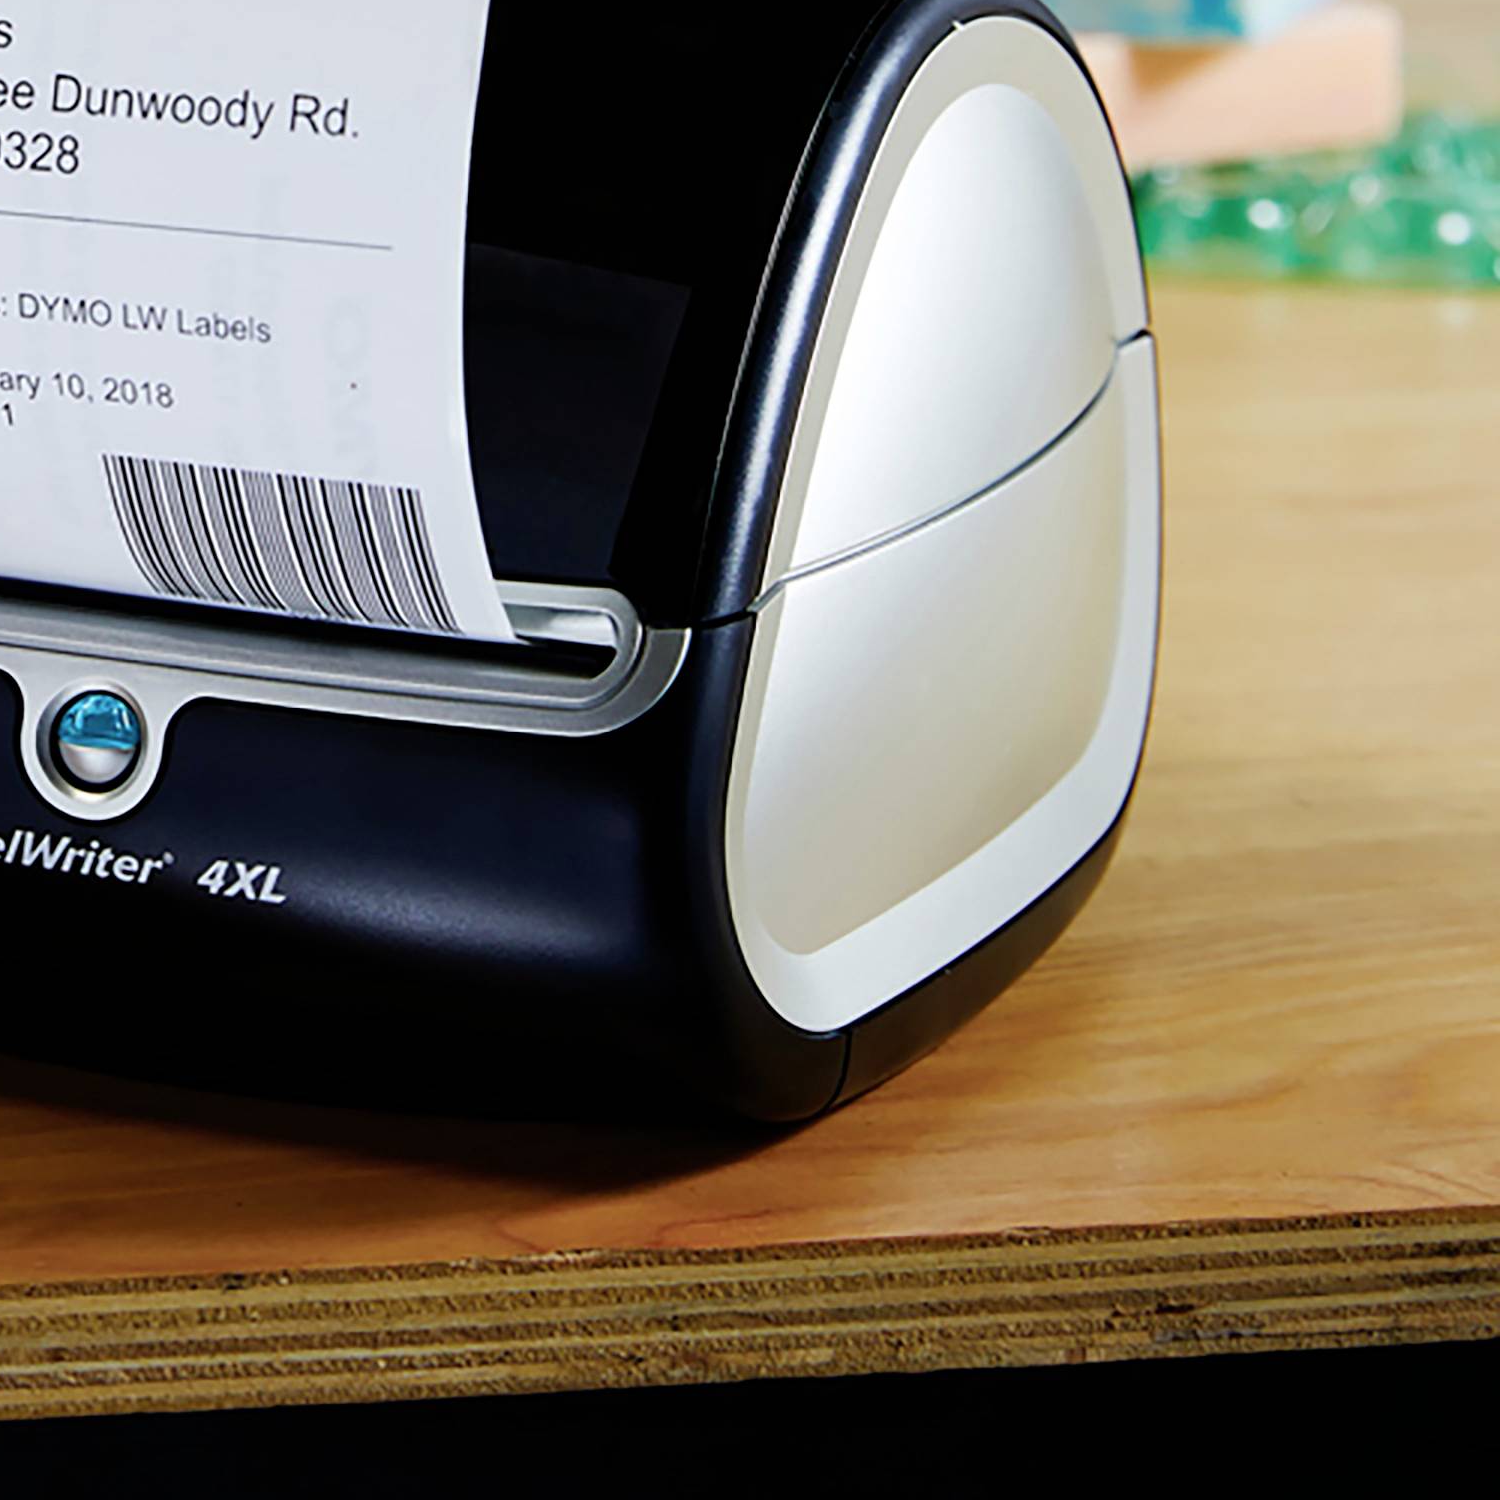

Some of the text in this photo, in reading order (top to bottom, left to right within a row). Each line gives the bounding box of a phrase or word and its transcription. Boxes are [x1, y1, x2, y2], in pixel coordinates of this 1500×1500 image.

[52, 74, 274, 140] Dunwoody
[290, 94, 358, 137] Rd.
[19, 293, 112, 327] DYMO
[123, 304, 167, 331] LW
[177, 309, 271, 343] Labels
[54, 373, 93, 402] 10,
[103, 378, 173, 408] 2018
[3, 404, 13, 425] 1
[197, 860, 286, 903] 4XL
